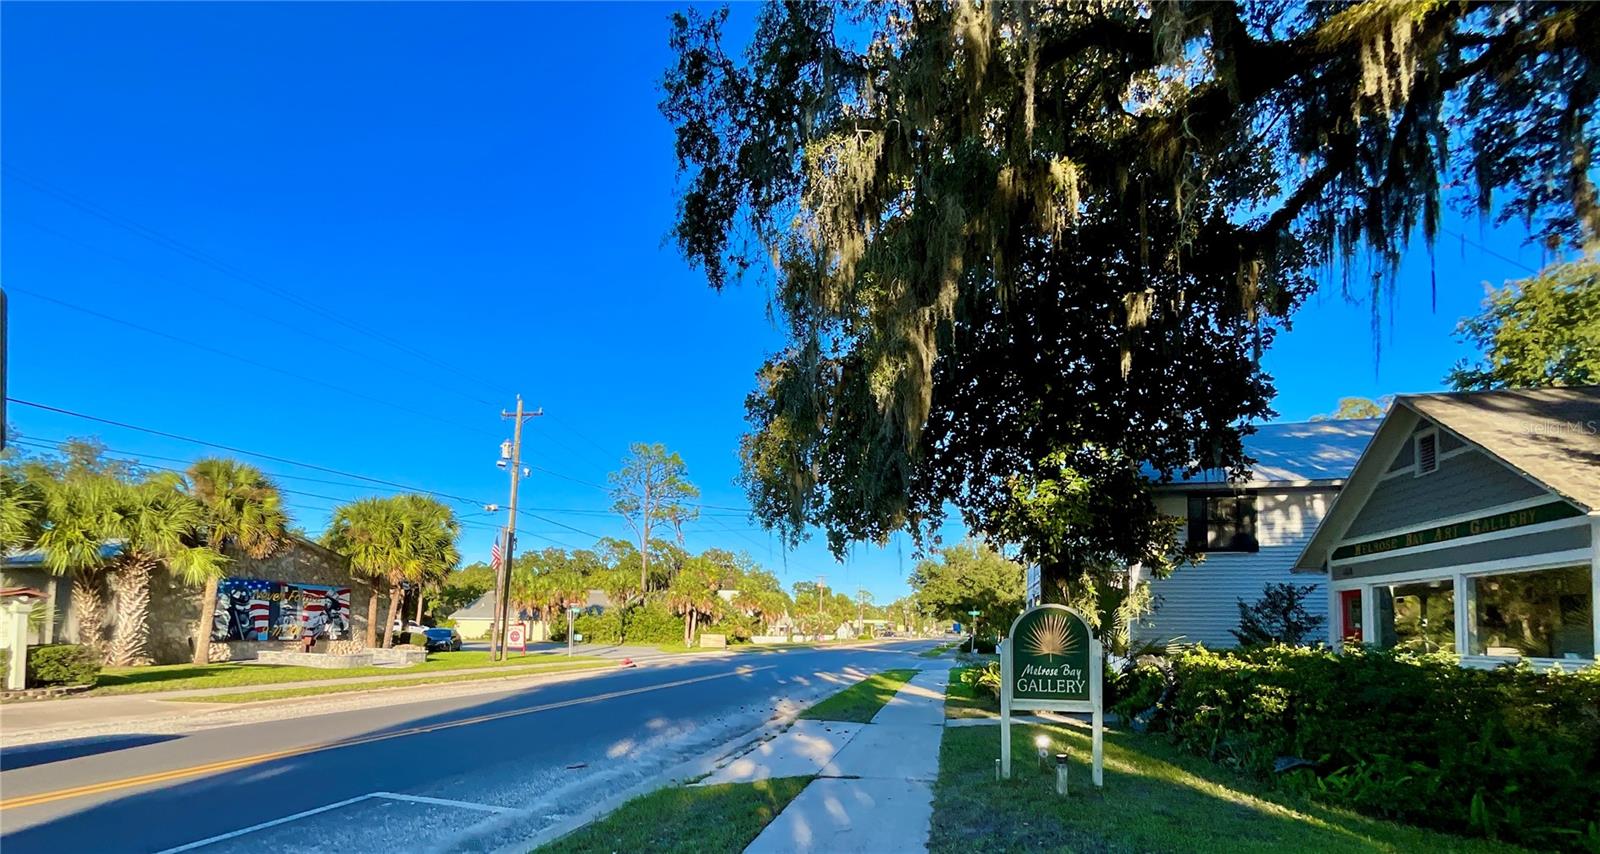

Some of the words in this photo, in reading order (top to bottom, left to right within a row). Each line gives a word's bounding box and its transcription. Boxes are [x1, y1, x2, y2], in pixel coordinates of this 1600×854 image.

[1021, 664, 1059, 677] Melrose
[1060, 664, 1082, 680] Bay
[1017, 679, 1086, 693] GALLERY
